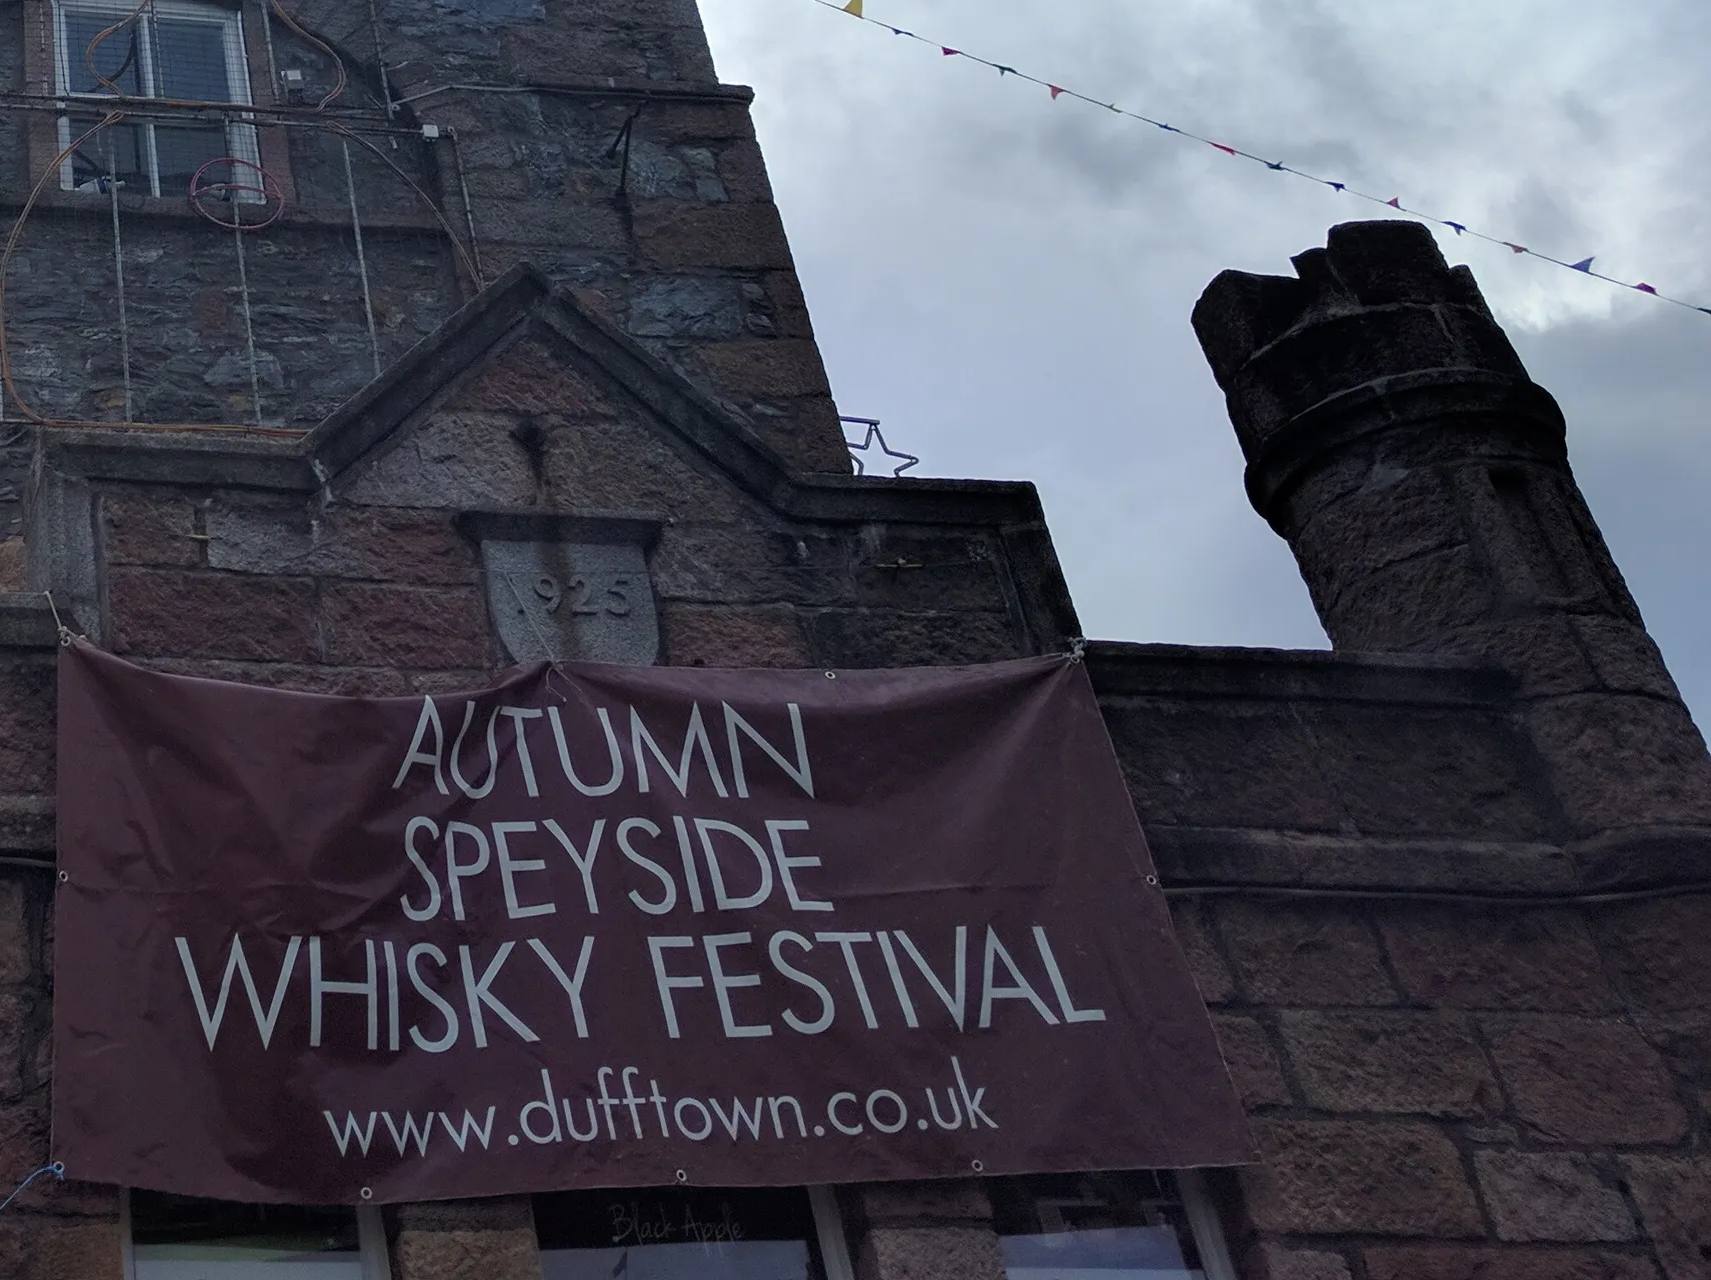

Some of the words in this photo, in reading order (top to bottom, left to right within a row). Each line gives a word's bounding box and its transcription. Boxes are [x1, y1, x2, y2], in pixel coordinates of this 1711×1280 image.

[392, 693, 817, 801] AUTUMN
[399, 814, 836, 922] SPEYSIDE
[174, 933, 596, 1055] WHISKY
[647, 923, 1107, 1040] FESTIVAL
[323, 1056, 1000, 1159] www.dufftown.co.uk
[607, 1201, 676, 1246] Black
[681, 1201, 745, 1258] Apple
